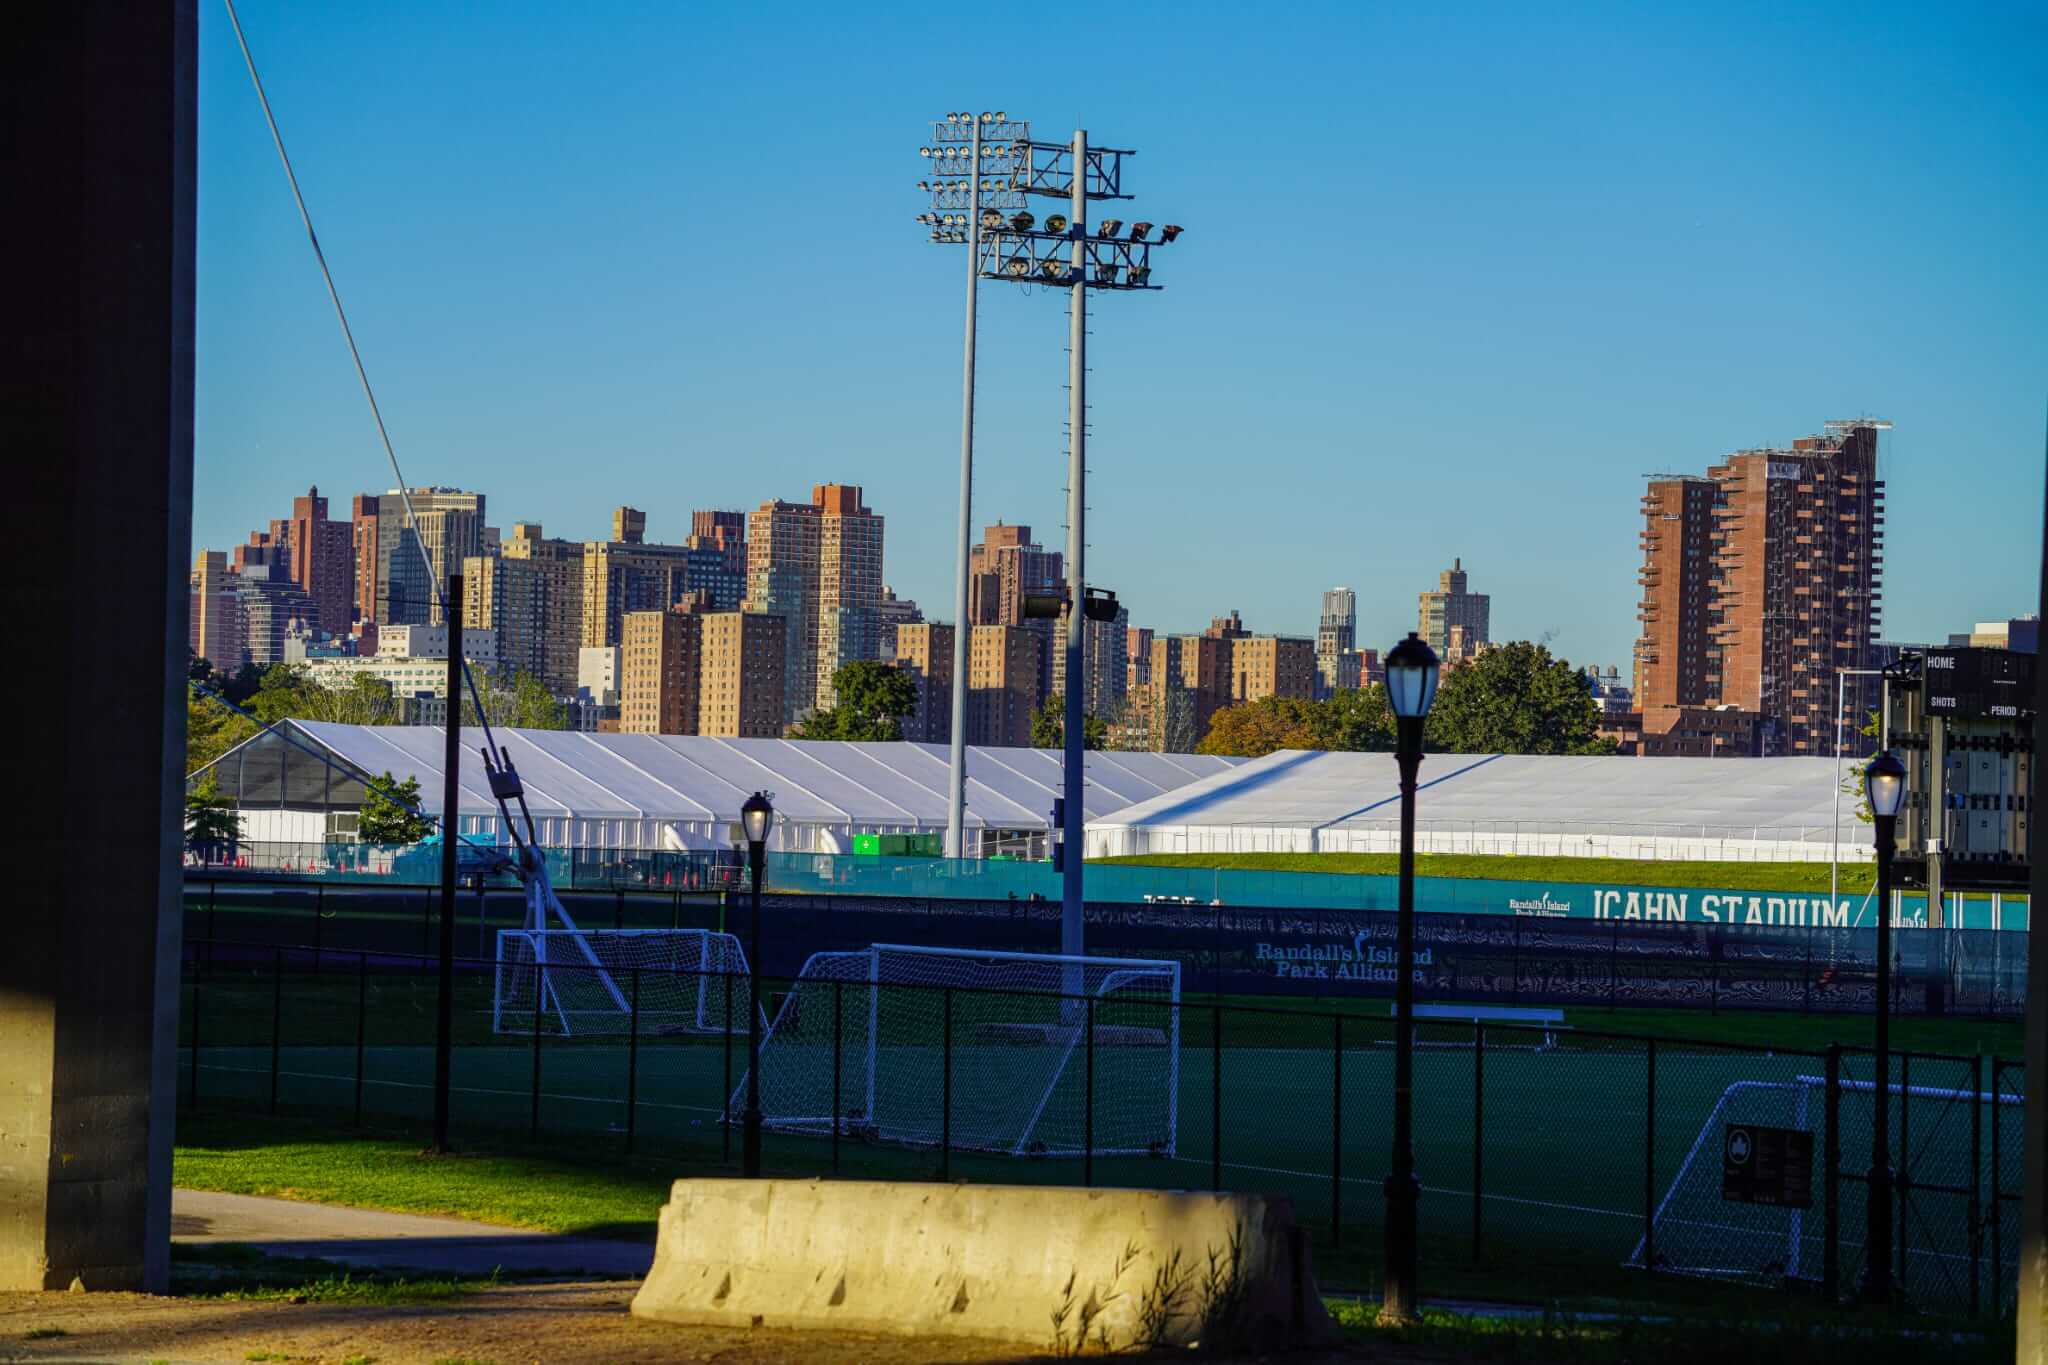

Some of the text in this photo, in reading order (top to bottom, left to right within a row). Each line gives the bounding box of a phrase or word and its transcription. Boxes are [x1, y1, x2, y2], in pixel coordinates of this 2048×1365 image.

[1927, 656, 1955, 670] HOME
[1930, 697, 1957, 708] SHOTS
[1991, 705, 2017, 717] PERIOD
[1547, 900, 1570, 911] Island
[1593, 890, 1688, 922] ICAHN
[1255, 943, 1353, 961] Randall's
[1274, 961, 1425, 981] Park Alliane
